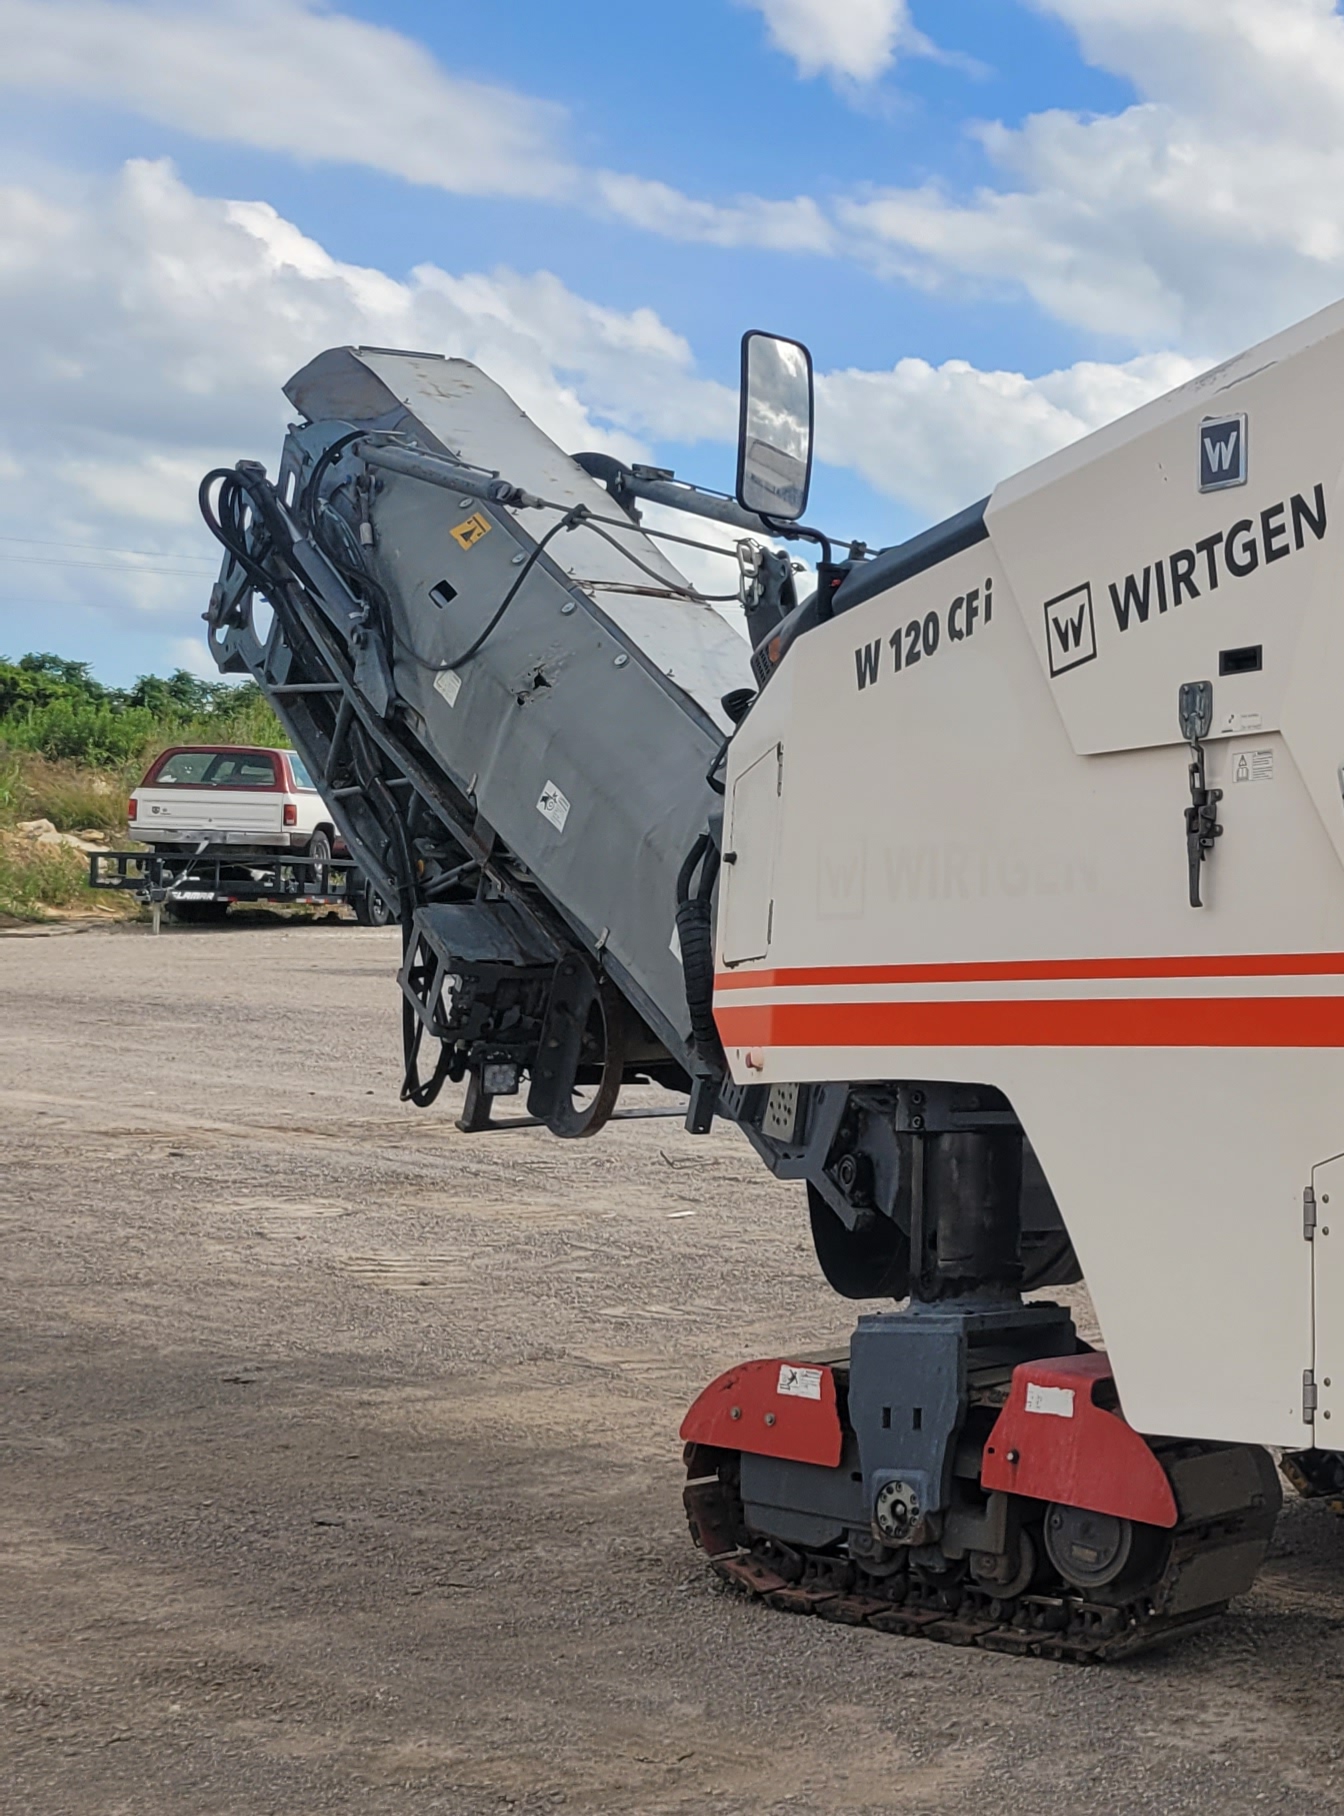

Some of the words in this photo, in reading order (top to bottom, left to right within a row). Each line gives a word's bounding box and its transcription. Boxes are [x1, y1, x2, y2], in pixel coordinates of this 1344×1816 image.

[1203, 431, 1237, 473] W
[1108, 482, 1327, 632] WIRTGEN
[855, 637, 881, 691] W
[889, 610, 940, 673] 120
